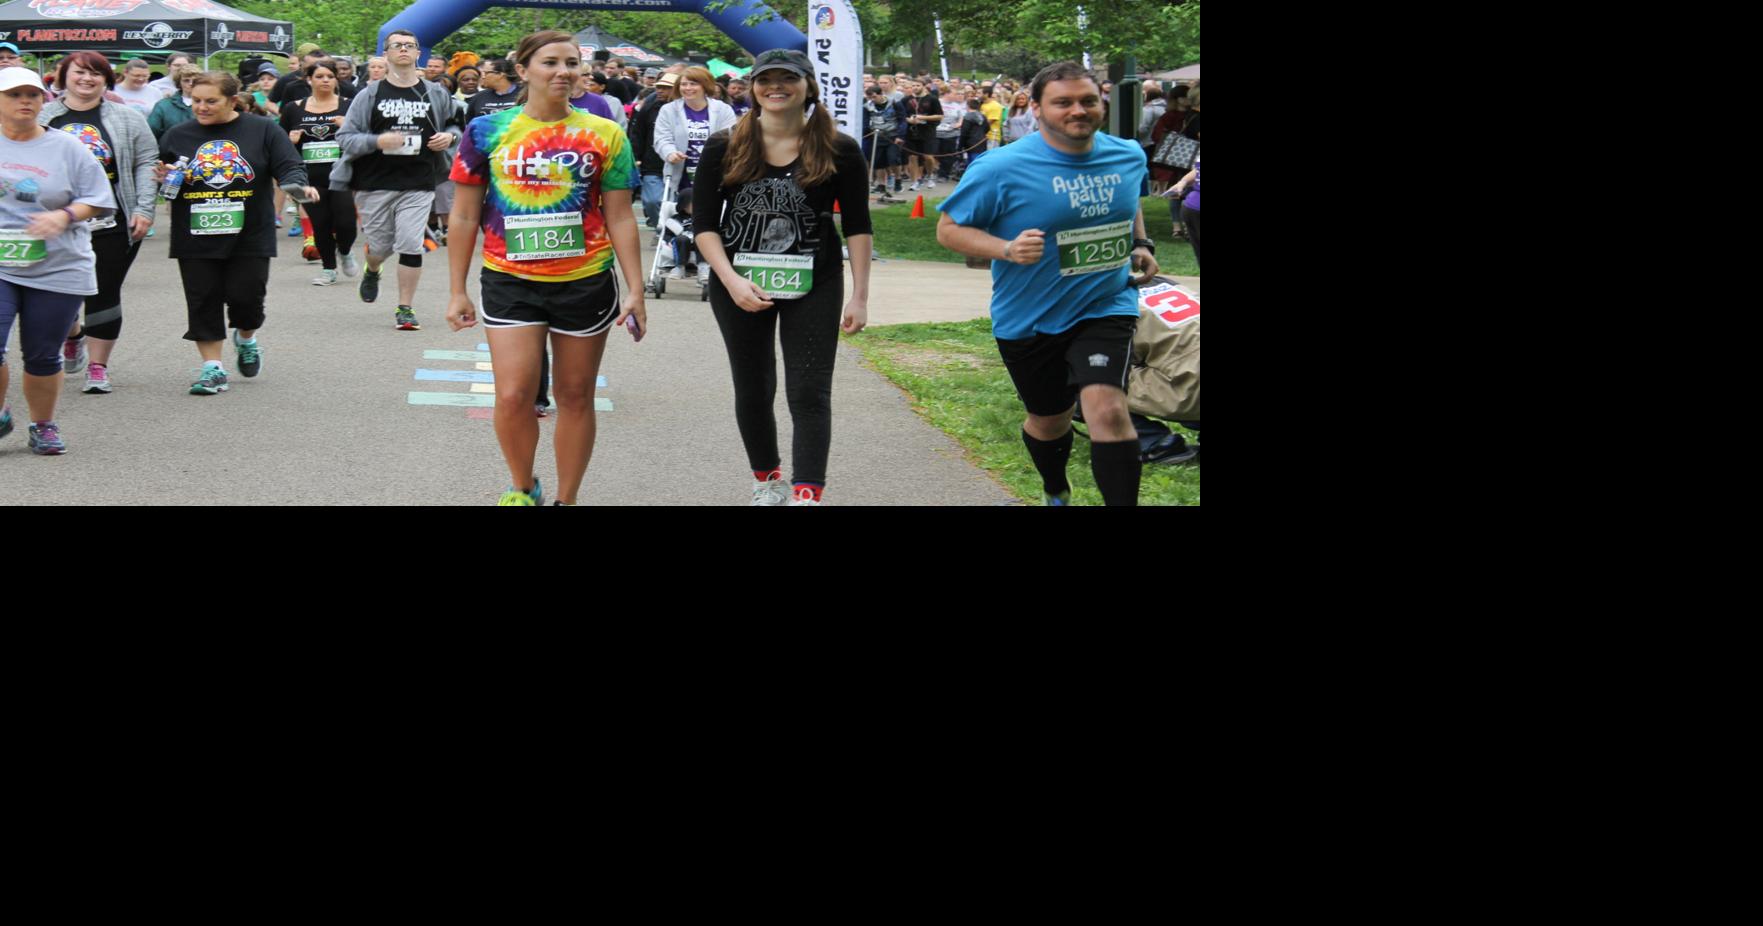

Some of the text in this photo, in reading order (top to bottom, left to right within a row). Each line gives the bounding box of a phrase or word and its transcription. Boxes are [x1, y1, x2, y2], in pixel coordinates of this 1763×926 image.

[377, 101, 430, 111] CHARITY
[382, 109, 426, 118] CHOICE
[310, 149, 331, 158] 764
[1053, 173, 1122, 195] Autism
[734, 193, 814, 213] DARK
[1080, 204, 1110, 218] 2016
[200, 213, 233, 228] 823
[722, 208, 821, 252] SIDE
[514, 228, 575, 250] 1184
[0, 243, 32, 258] 27
[1069, 238, 1127, 265] 1250
[743, 268, 802, 289] 1164
